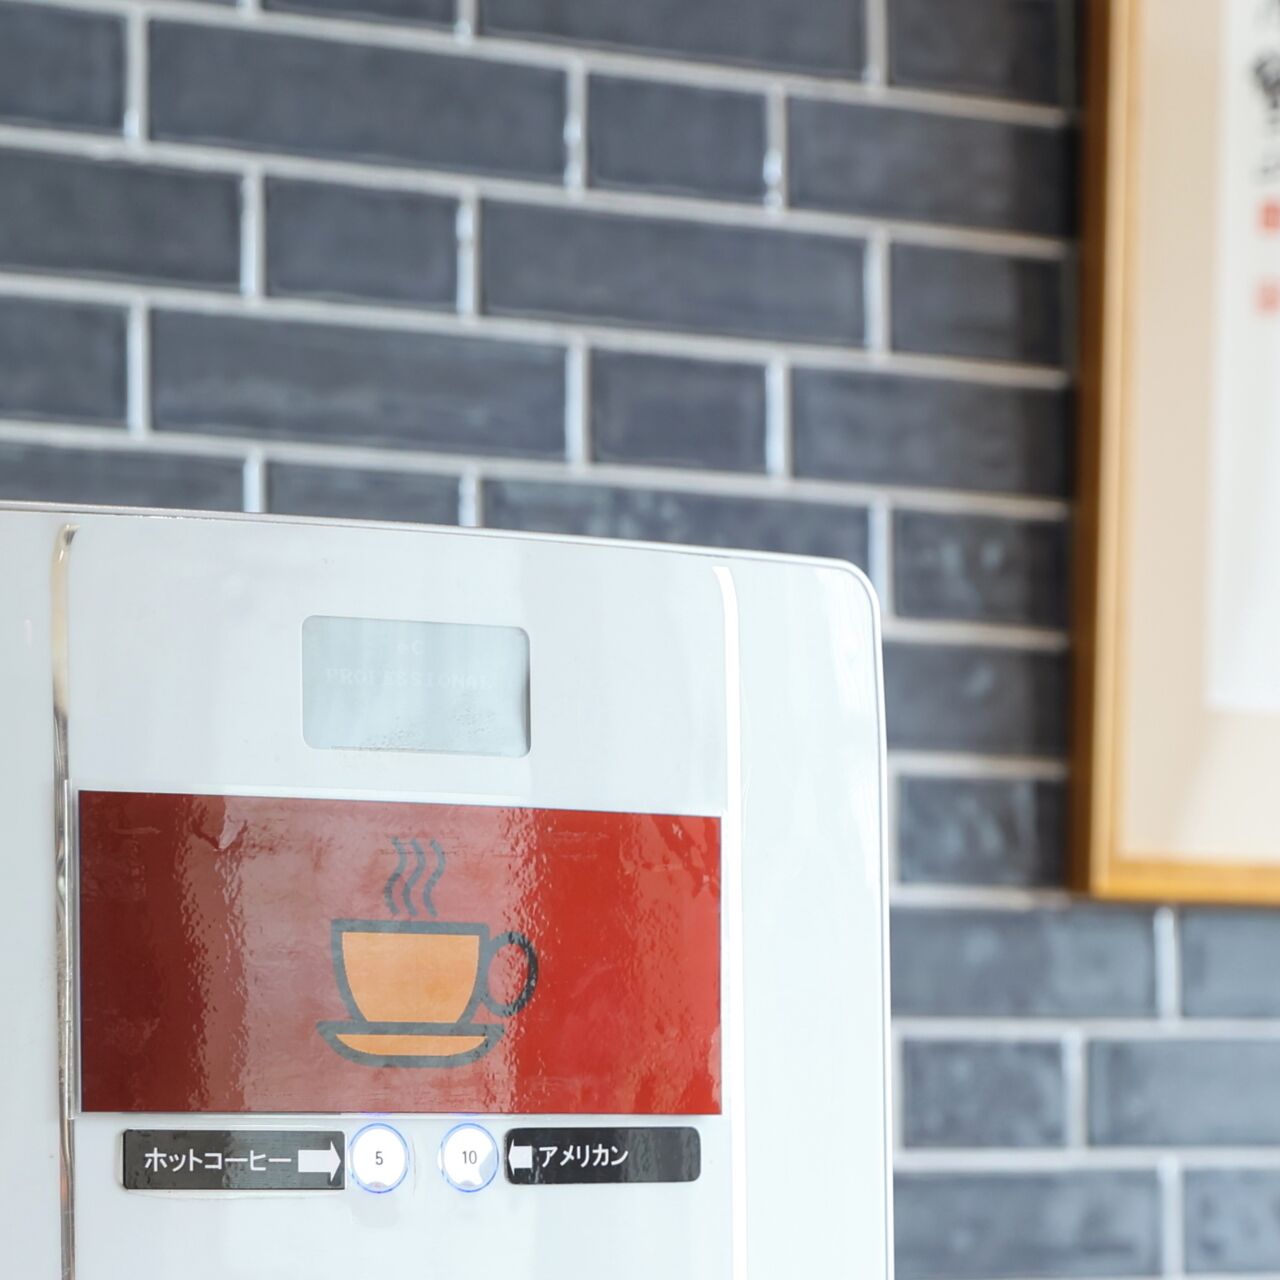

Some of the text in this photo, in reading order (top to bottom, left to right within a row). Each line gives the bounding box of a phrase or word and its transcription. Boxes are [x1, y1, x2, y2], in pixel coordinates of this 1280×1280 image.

[144, 1147, 292, 1173] ホットコーヒー
[374, 1150, 384, 1166] 5
[461, 1150, 478, 1165] 10
[538, 1143, 629, 1168] アメリカン
